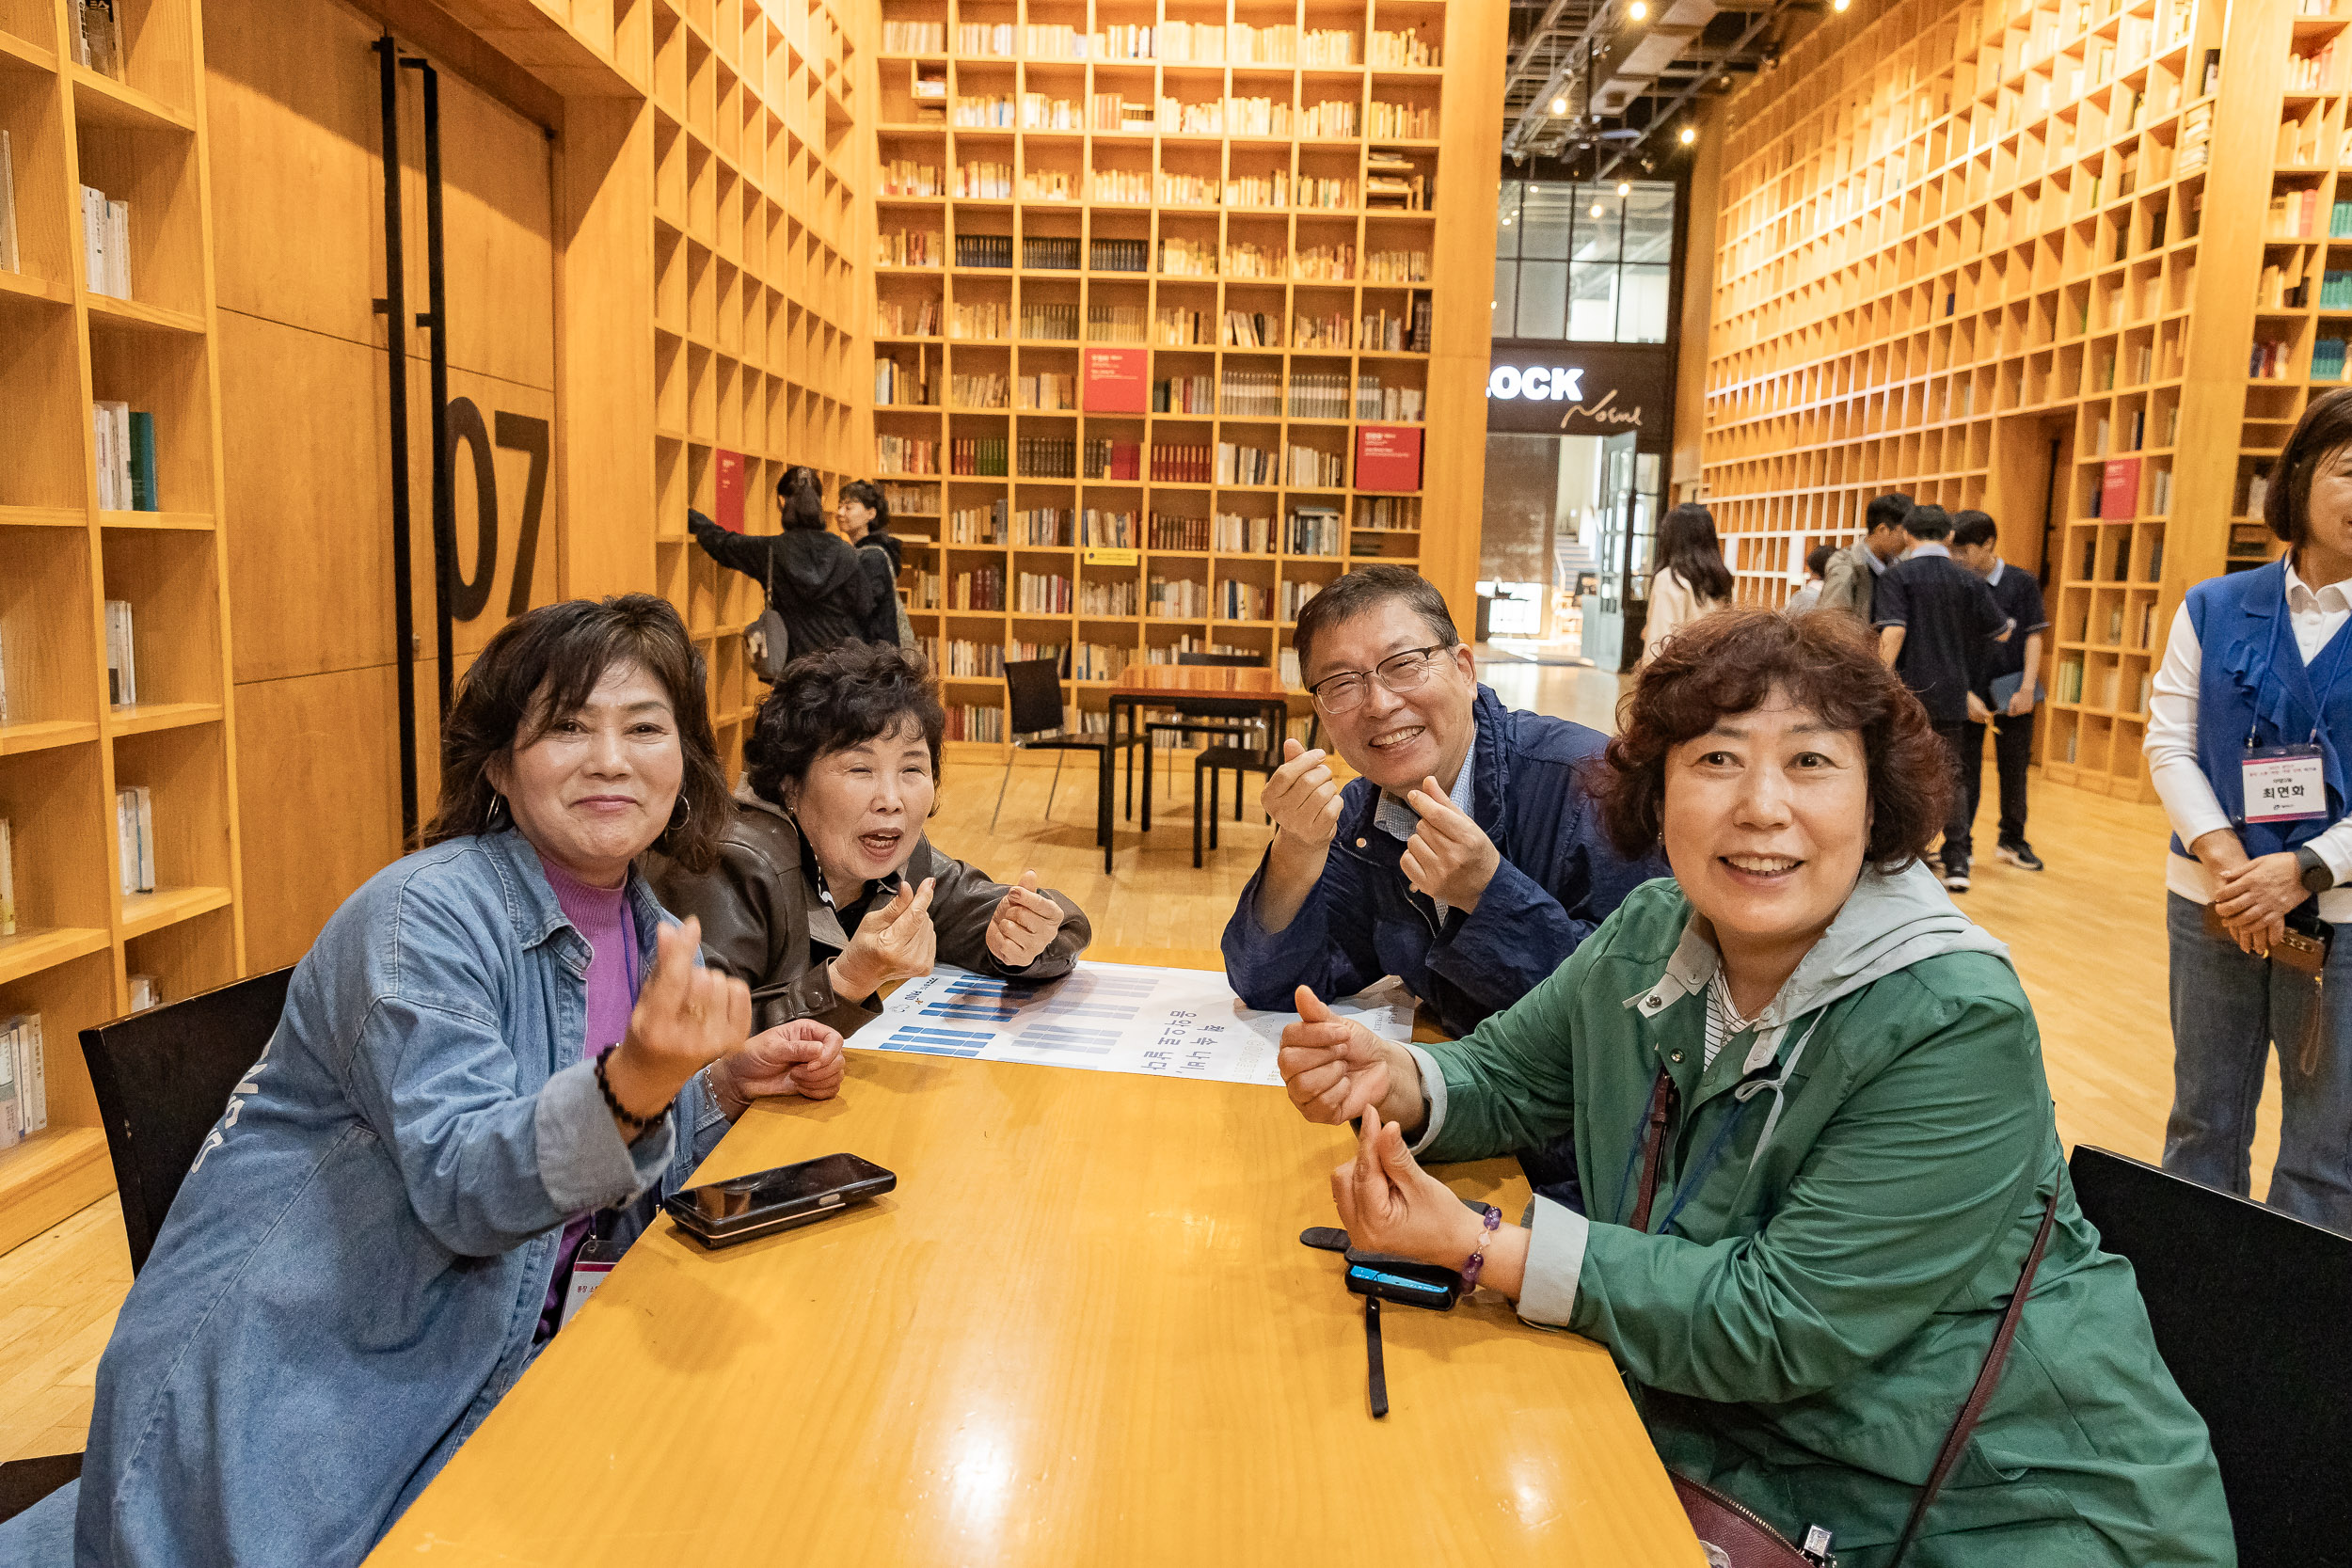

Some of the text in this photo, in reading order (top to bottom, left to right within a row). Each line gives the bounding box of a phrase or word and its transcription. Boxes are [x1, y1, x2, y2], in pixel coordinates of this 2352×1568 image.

[1486, 365, 1584, 401] OCK
[446, 396, 549, 622] 07
[1140, 1010, 1198, 1070] 음악으로 날다
